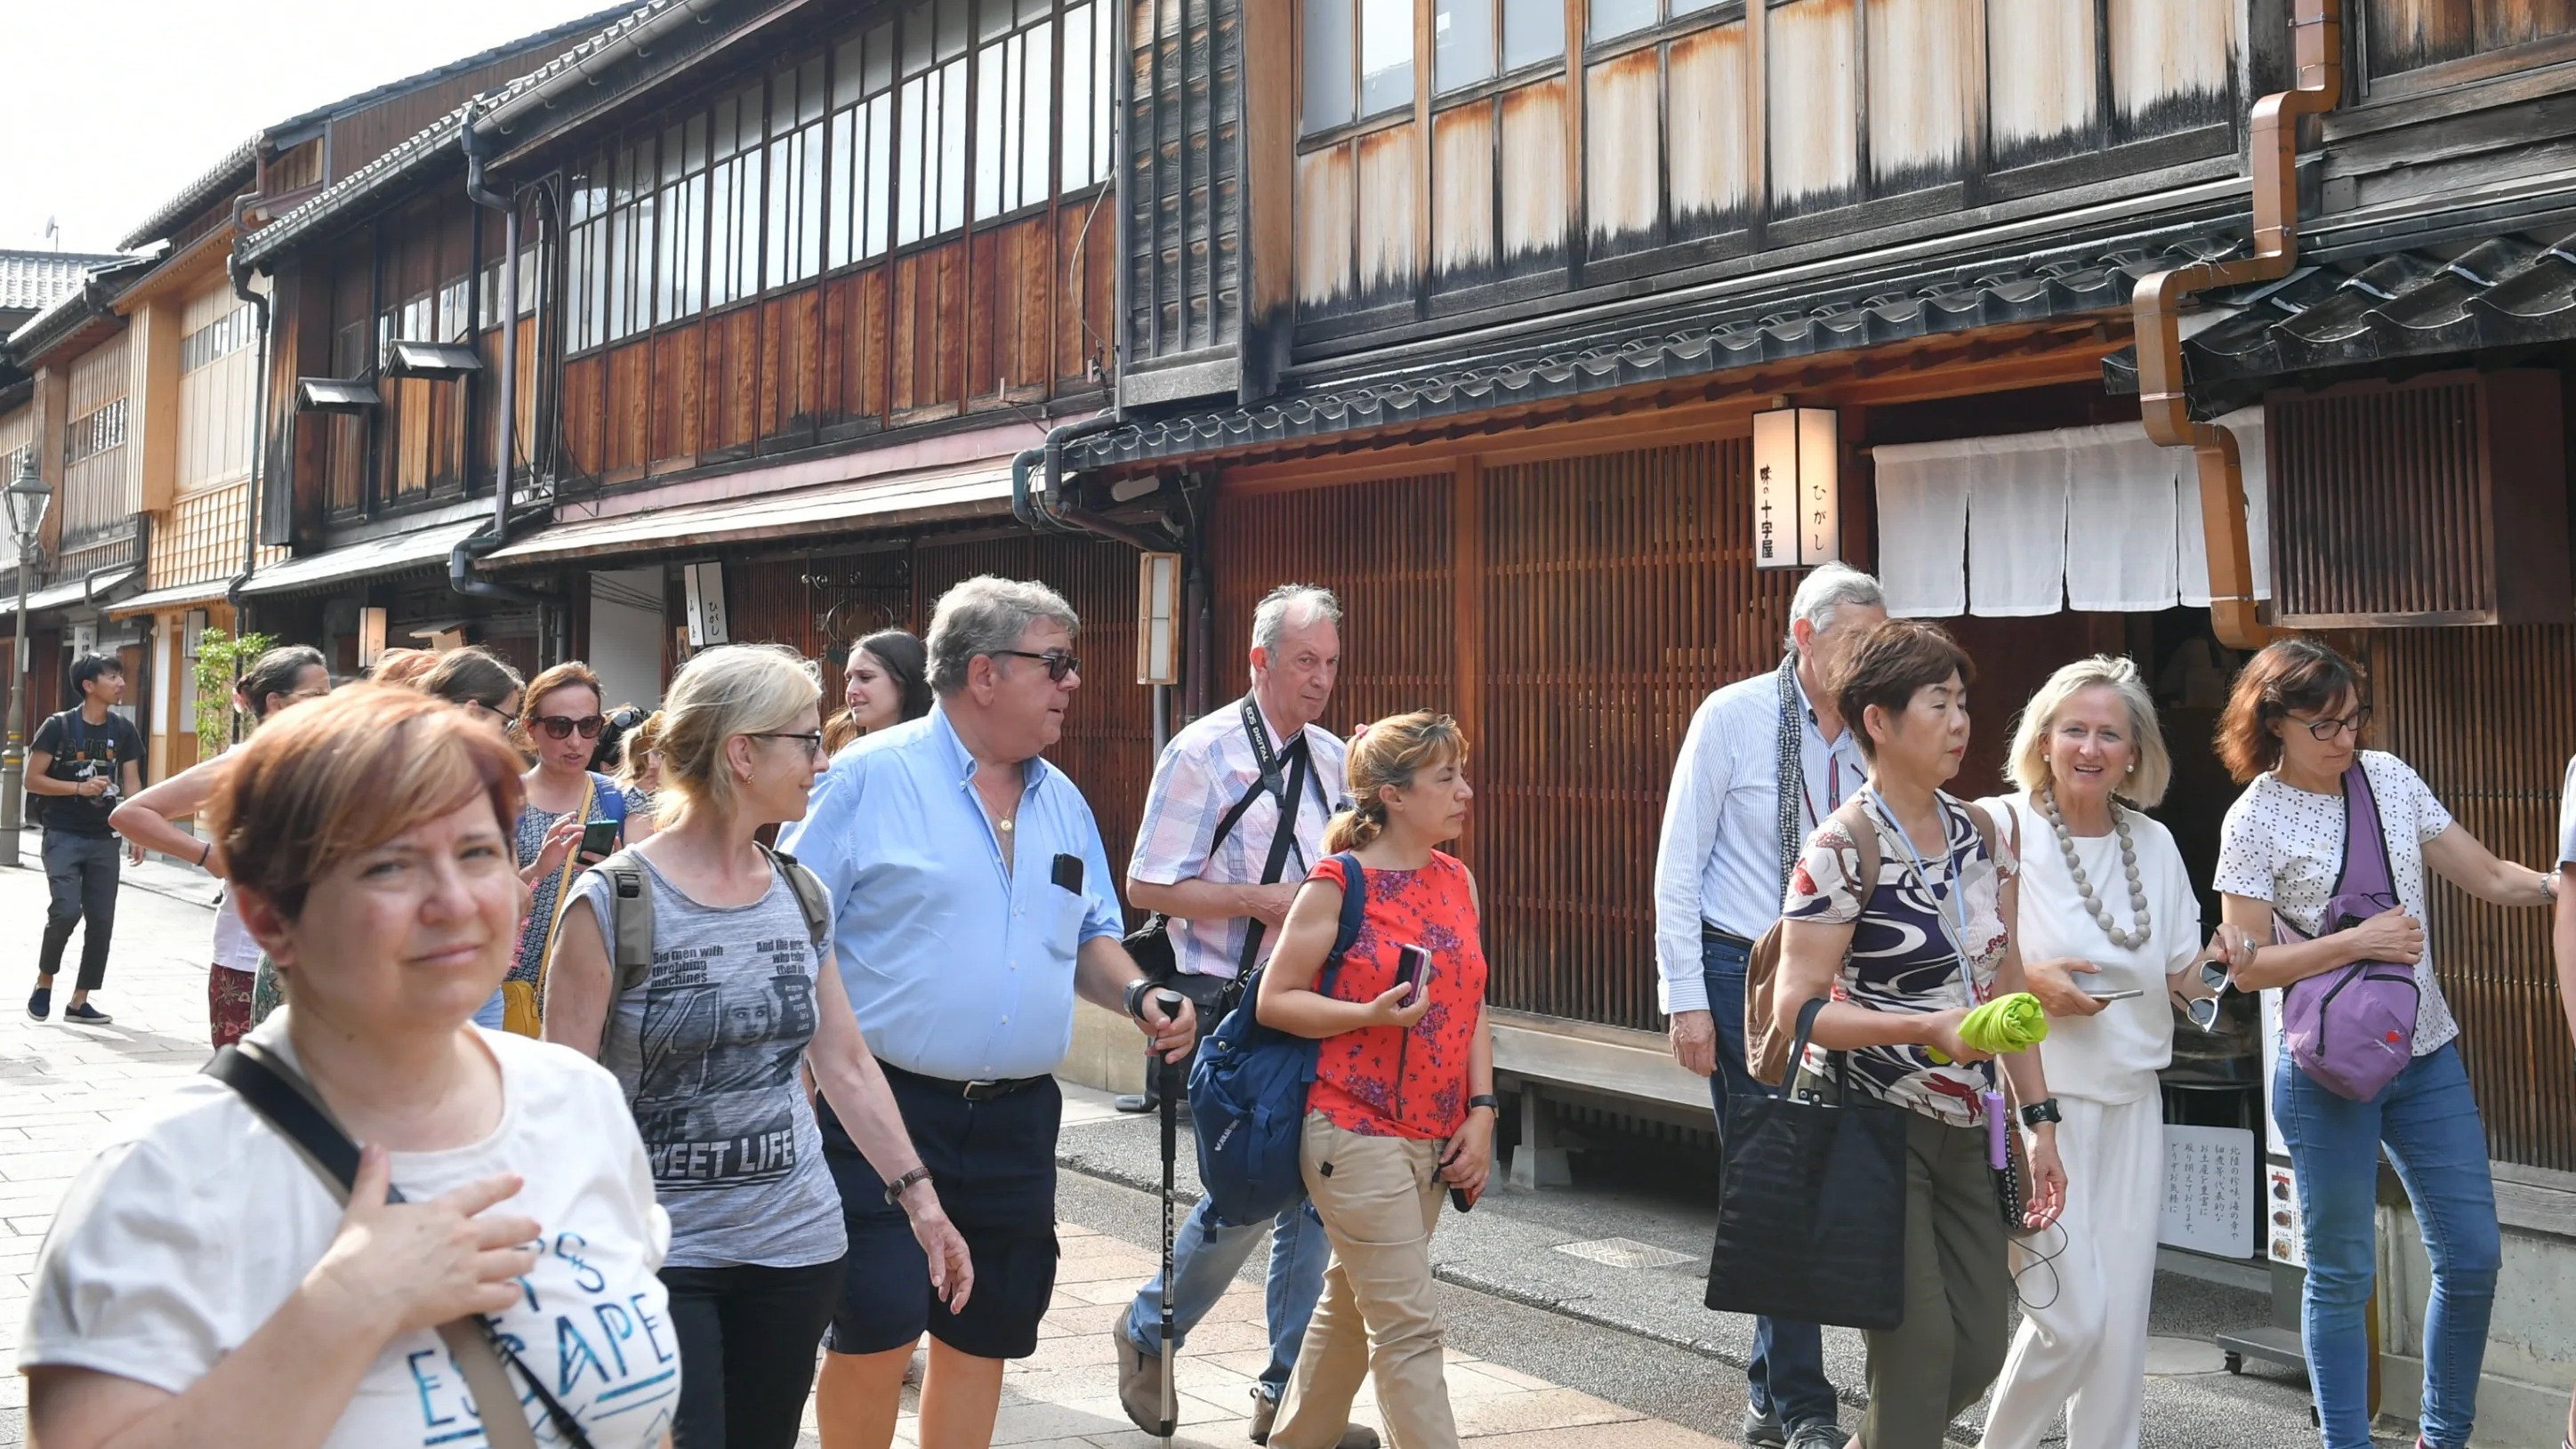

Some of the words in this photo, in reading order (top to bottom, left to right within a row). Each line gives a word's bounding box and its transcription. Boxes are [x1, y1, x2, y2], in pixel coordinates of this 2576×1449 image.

[1759, 463, 1774, 559] 味の十字屋
[1813, 485, 1827, 551] ひがし
[708, 601, 720, 636] ひがし
[1245, 706, 1257, 725] EOS
[1252, 727, 1269, 763] DIGITAL
[652, 952, 670, 964] Big
[672, 948, 697, 961] men
[700, 945, 724, 957] with
[756, 940, 774, 953] And
[776, 939, 788, 950] the
[772, 952, 790, 963] who
[651, 972, 708, 987] machines
[652, 960, 707, 977] throbbing
[644, 1139, 731, 1178] WEET
[737, 1128, 794, 1173] LIFE
[408, 1293, 673, 1428] EAPE
